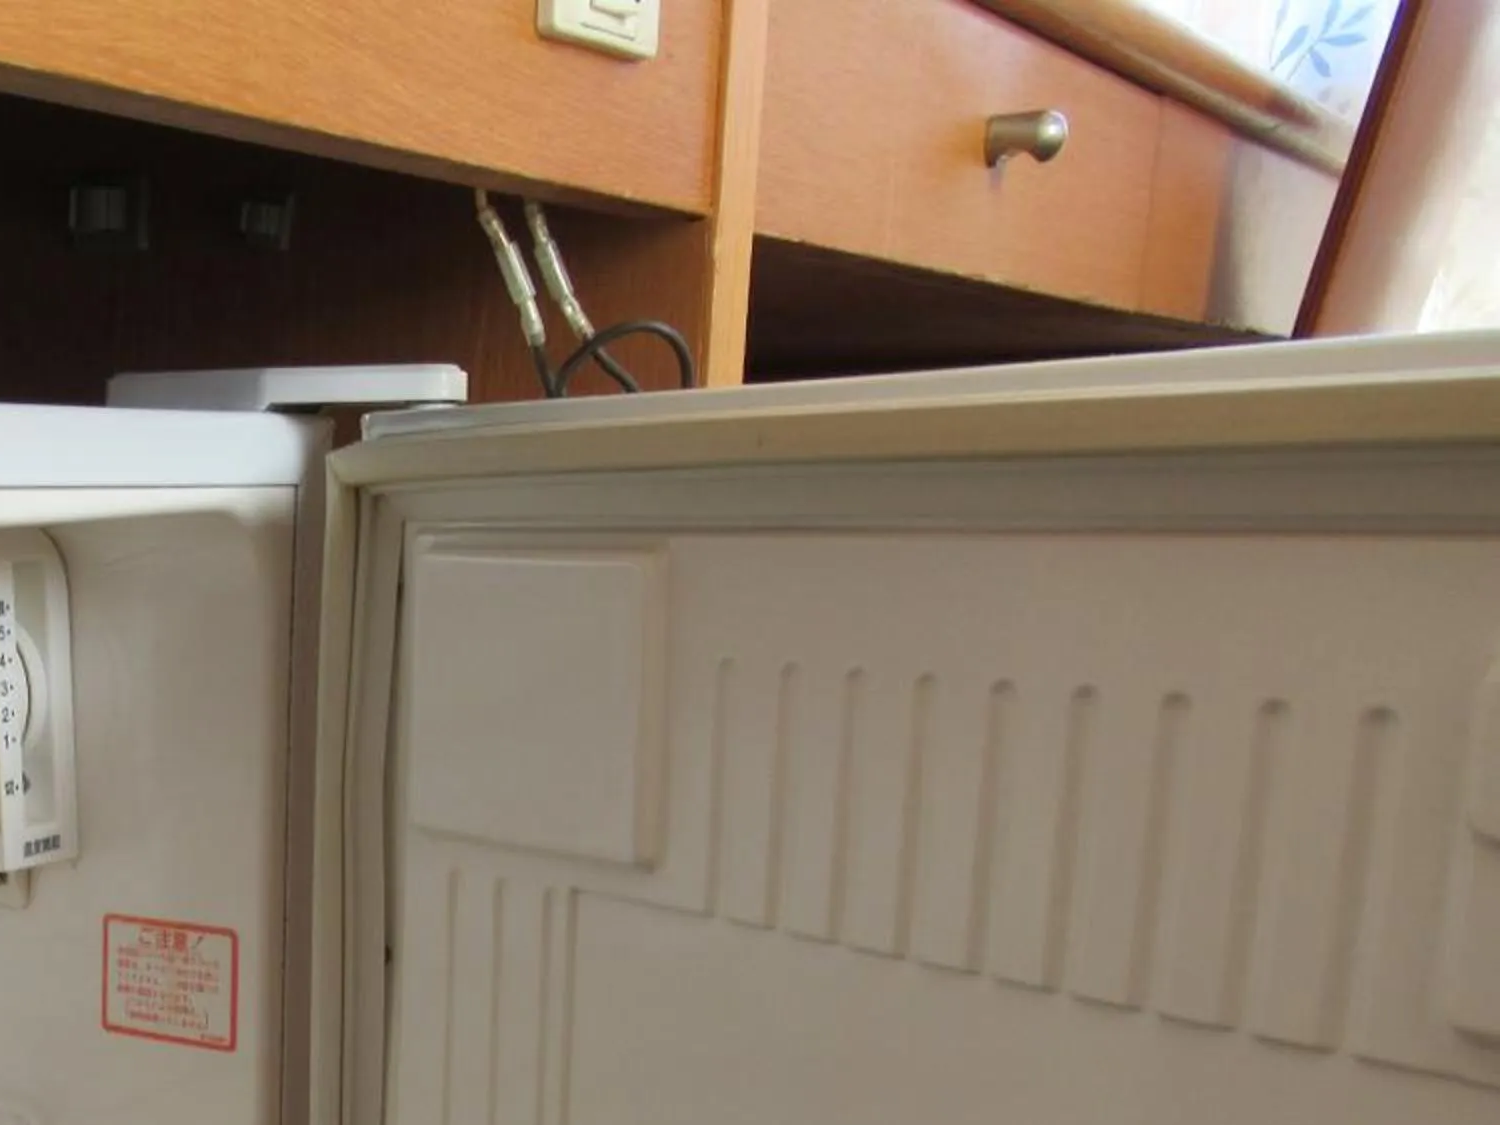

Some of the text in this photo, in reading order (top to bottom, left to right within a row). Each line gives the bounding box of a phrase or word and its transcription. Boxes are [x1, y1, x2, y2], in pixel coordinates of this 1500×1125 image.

[0, 681, 9, 696] 3
[2, 707, 10, 722] 2
[4, 734, 10, 749] 1
